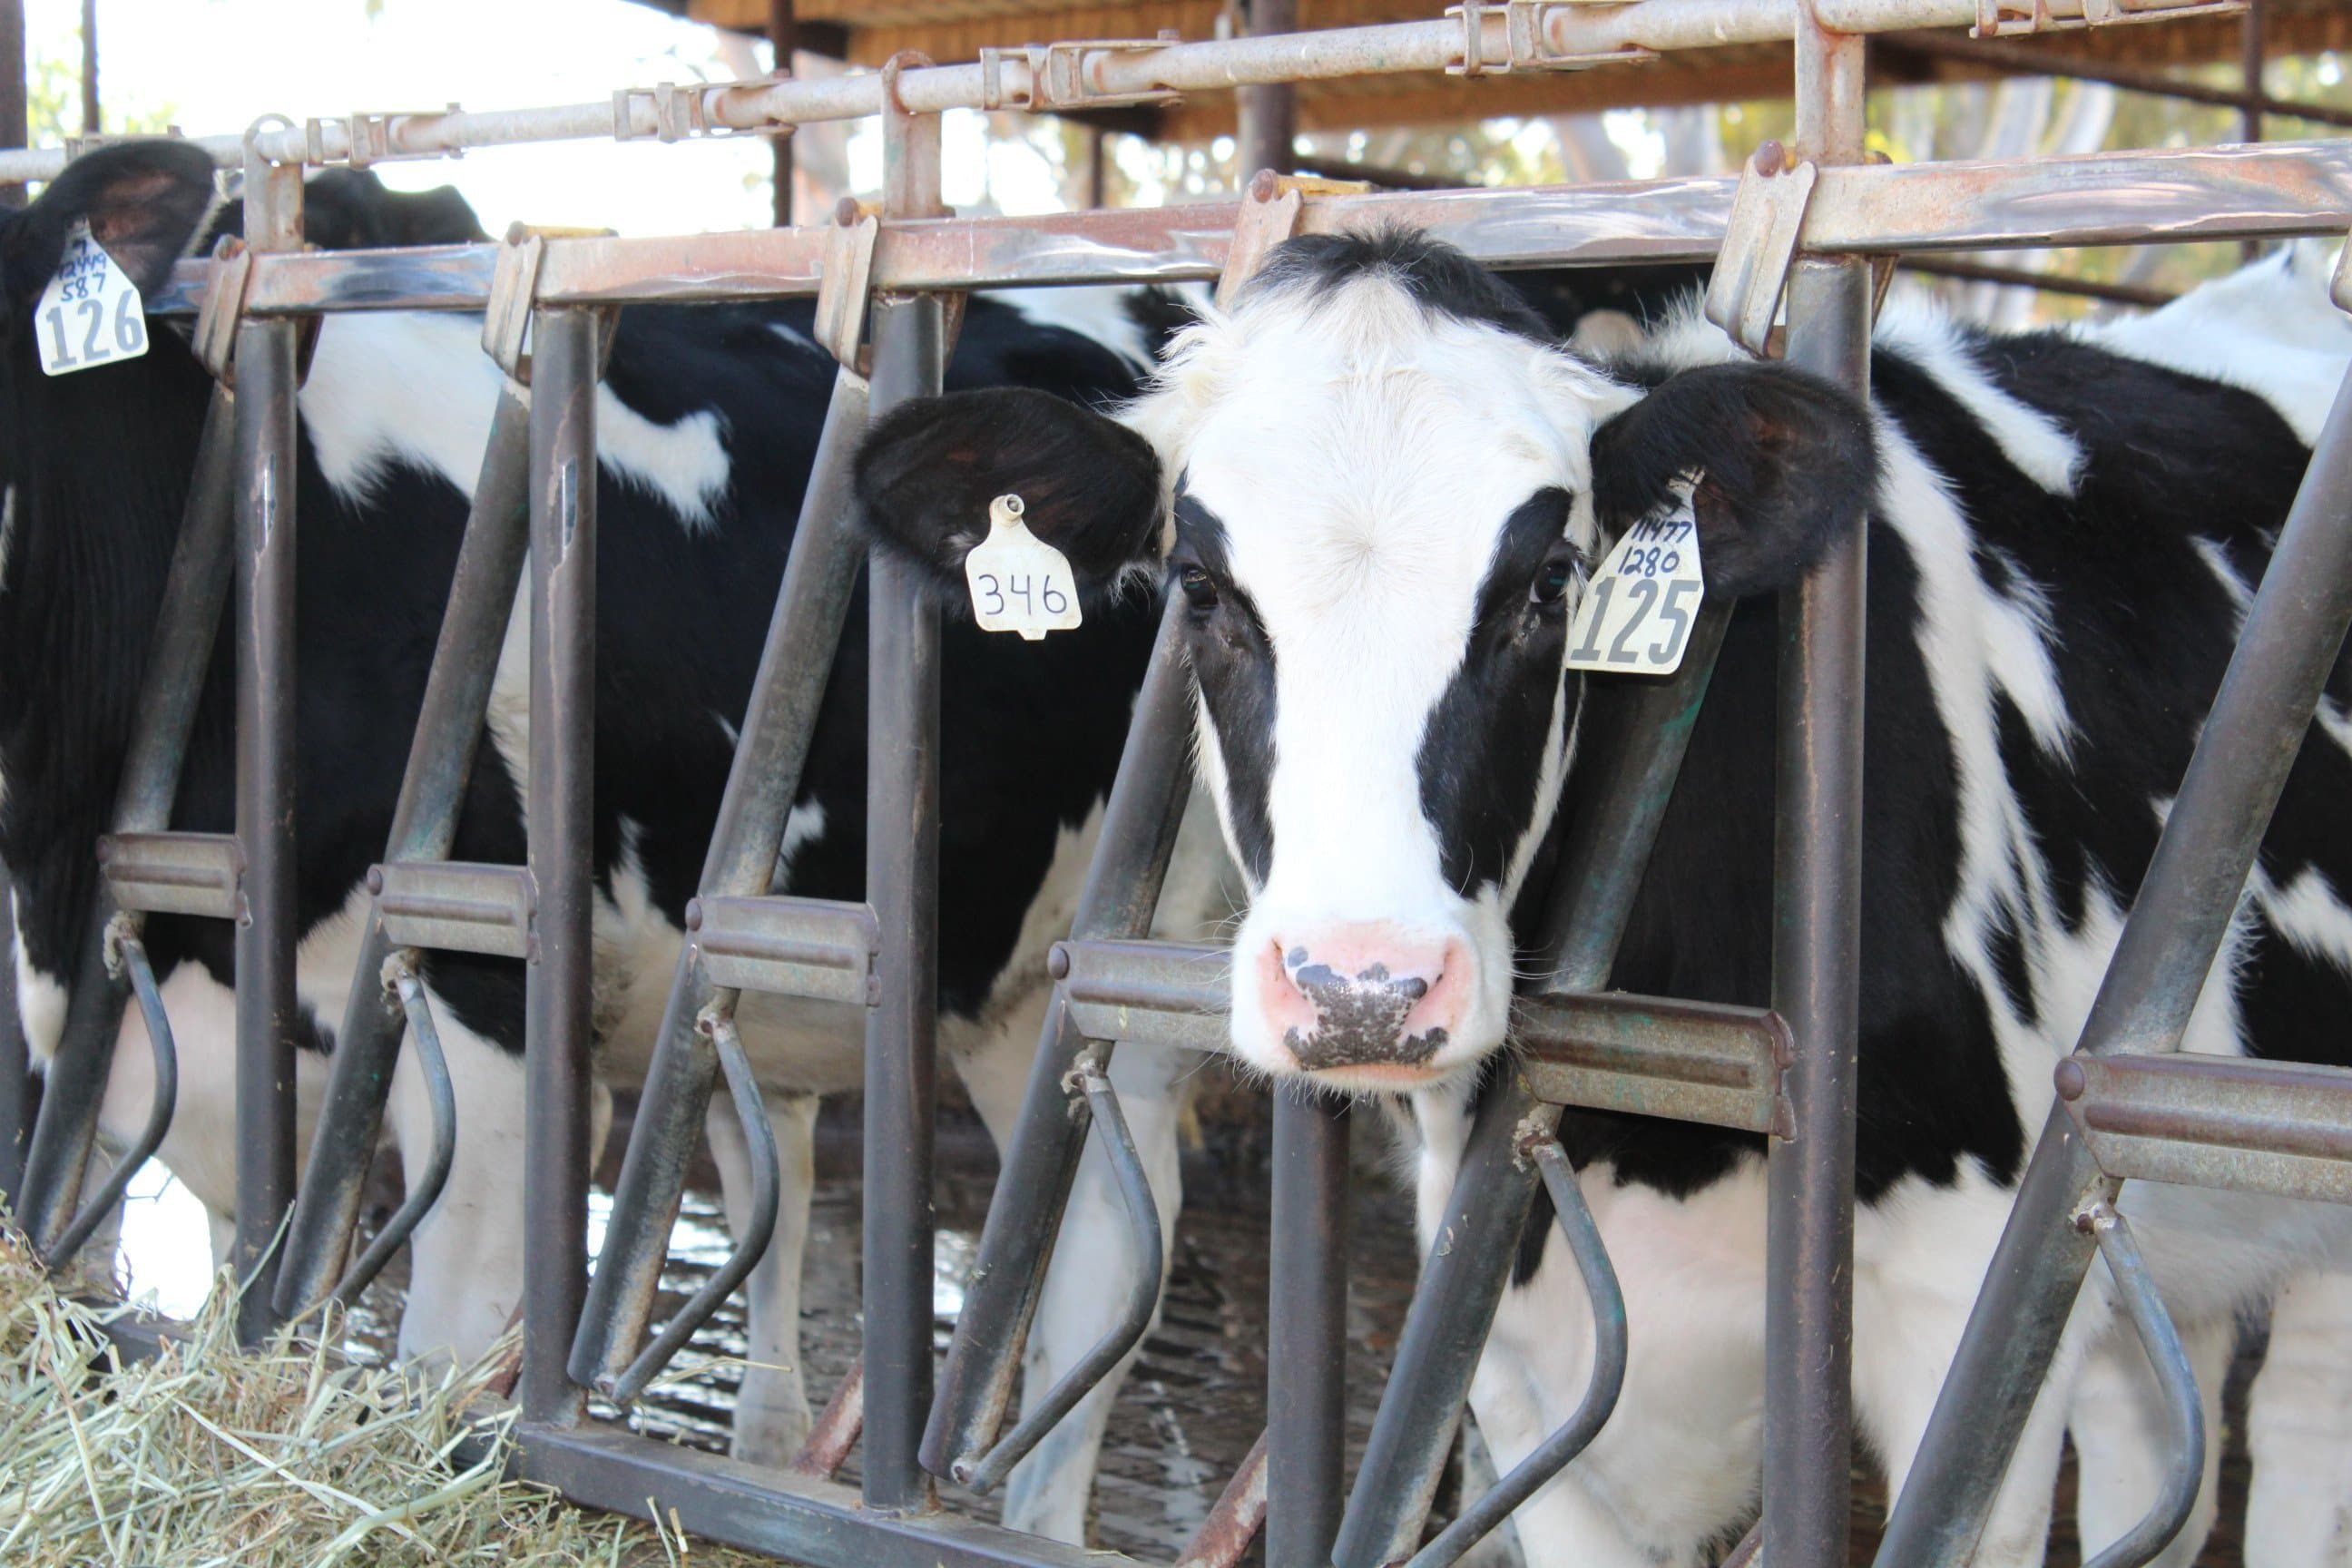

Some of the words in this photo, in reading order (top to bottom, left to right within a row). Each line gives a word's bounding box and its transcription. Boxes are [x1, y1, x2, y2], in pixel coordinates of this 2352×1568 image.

[60, 271, 106, 302] 587
[45, 289, 143, 370] 126
[1631, 516, 1693, 544] 11477
[1618, 546, 1681, 578] 1280
[978, 573, 1067, 616] 346
[1571, 576, 1701, 665] 125
